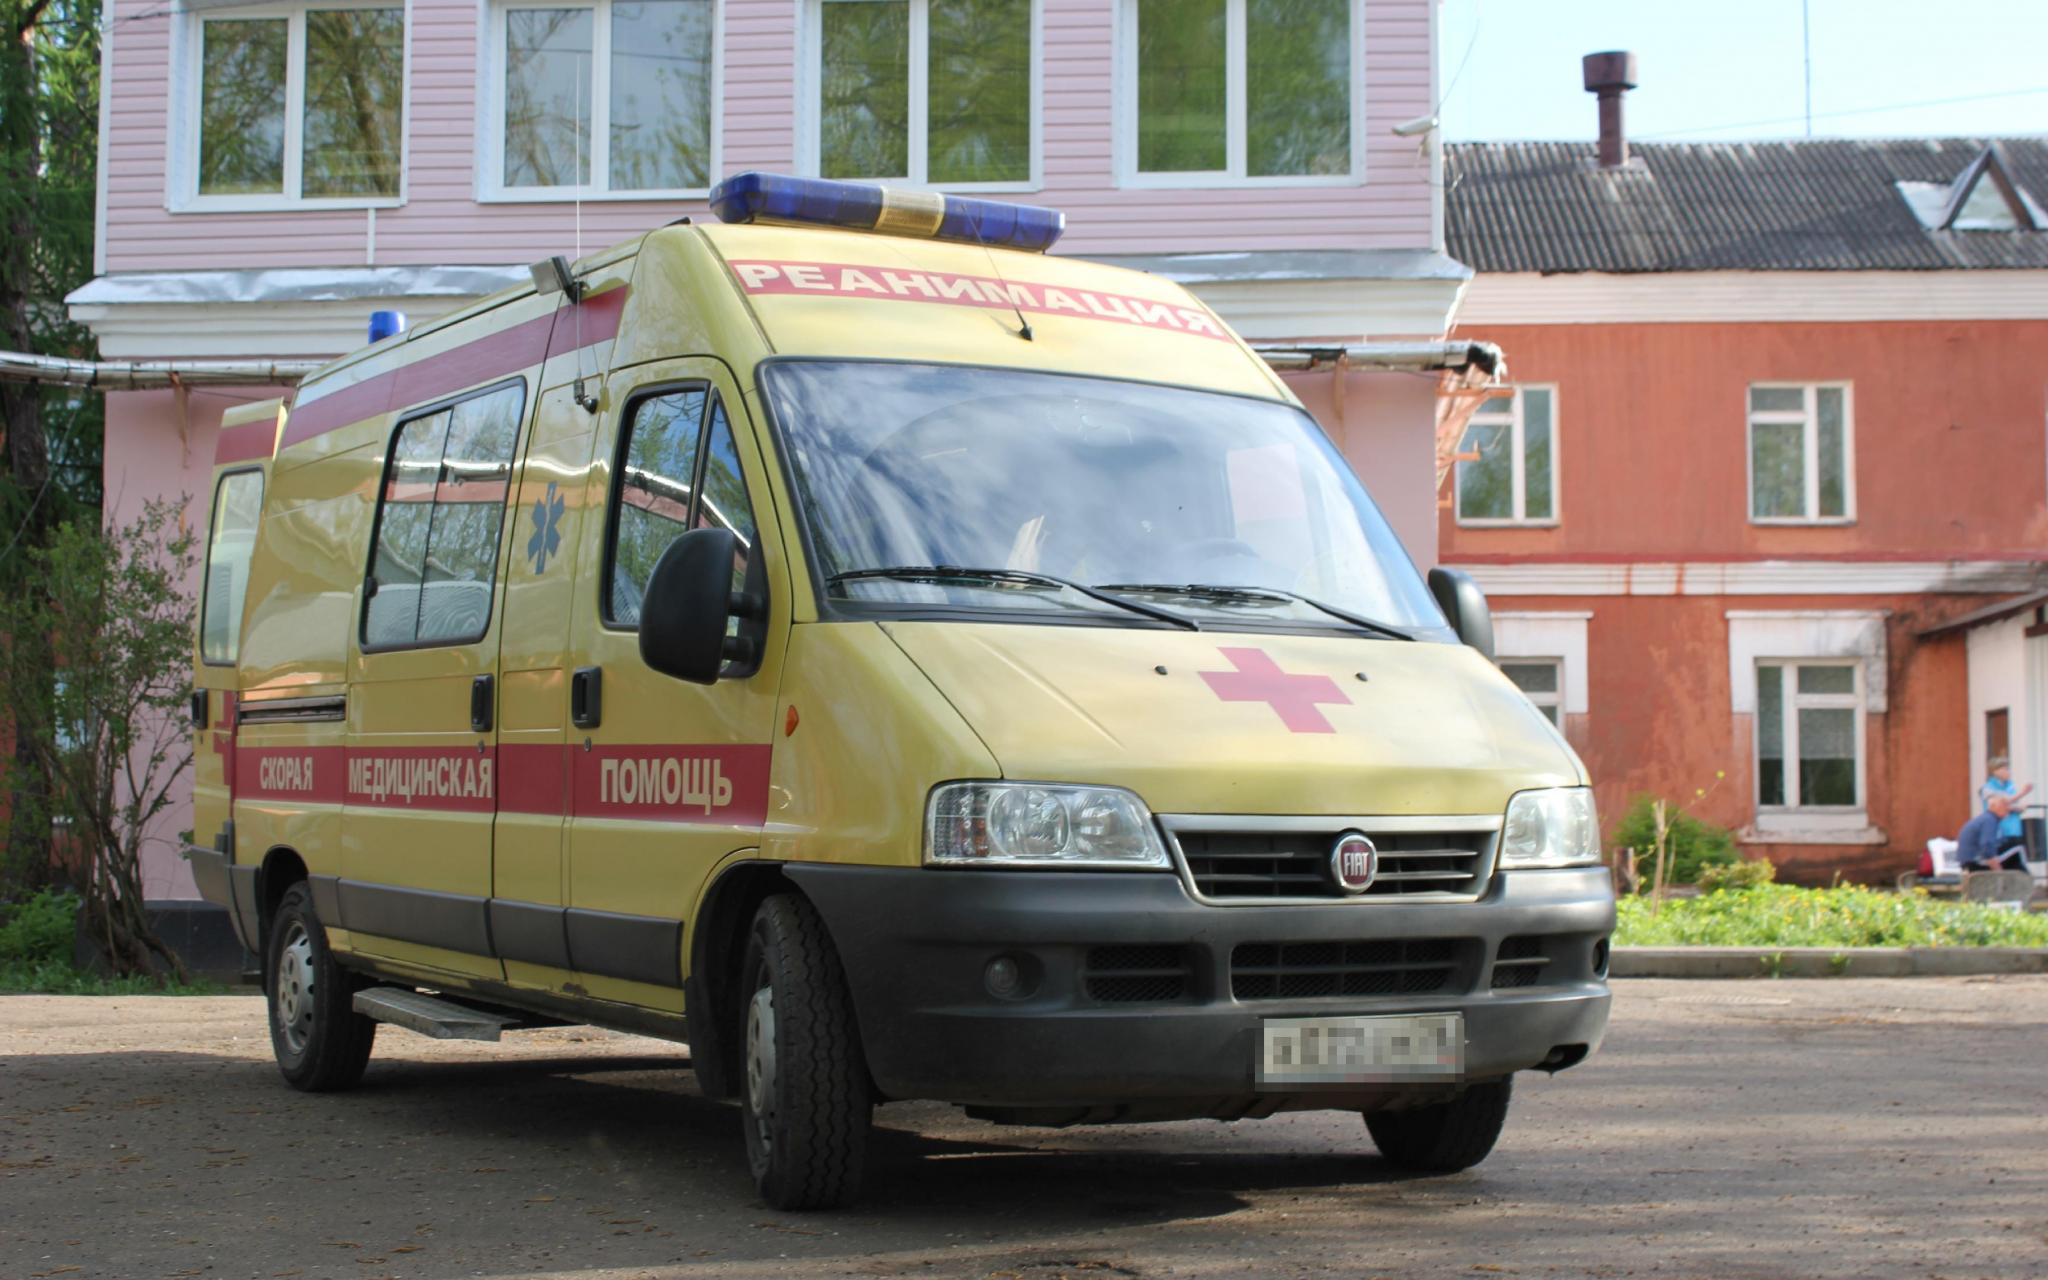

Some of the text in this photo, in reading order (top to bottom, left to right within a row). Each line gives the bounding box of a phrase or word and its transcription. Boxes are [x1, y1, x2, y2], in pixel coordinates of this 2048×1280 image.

[734, 264, 1225, 337] РЕАНИМАЦИЯ
[259, 756, 734, 815] СКОРАЯ МЕДИЦИНСКАЯ ПОМОЩЬ
[1344, 852, 1369, 876] FIAT
